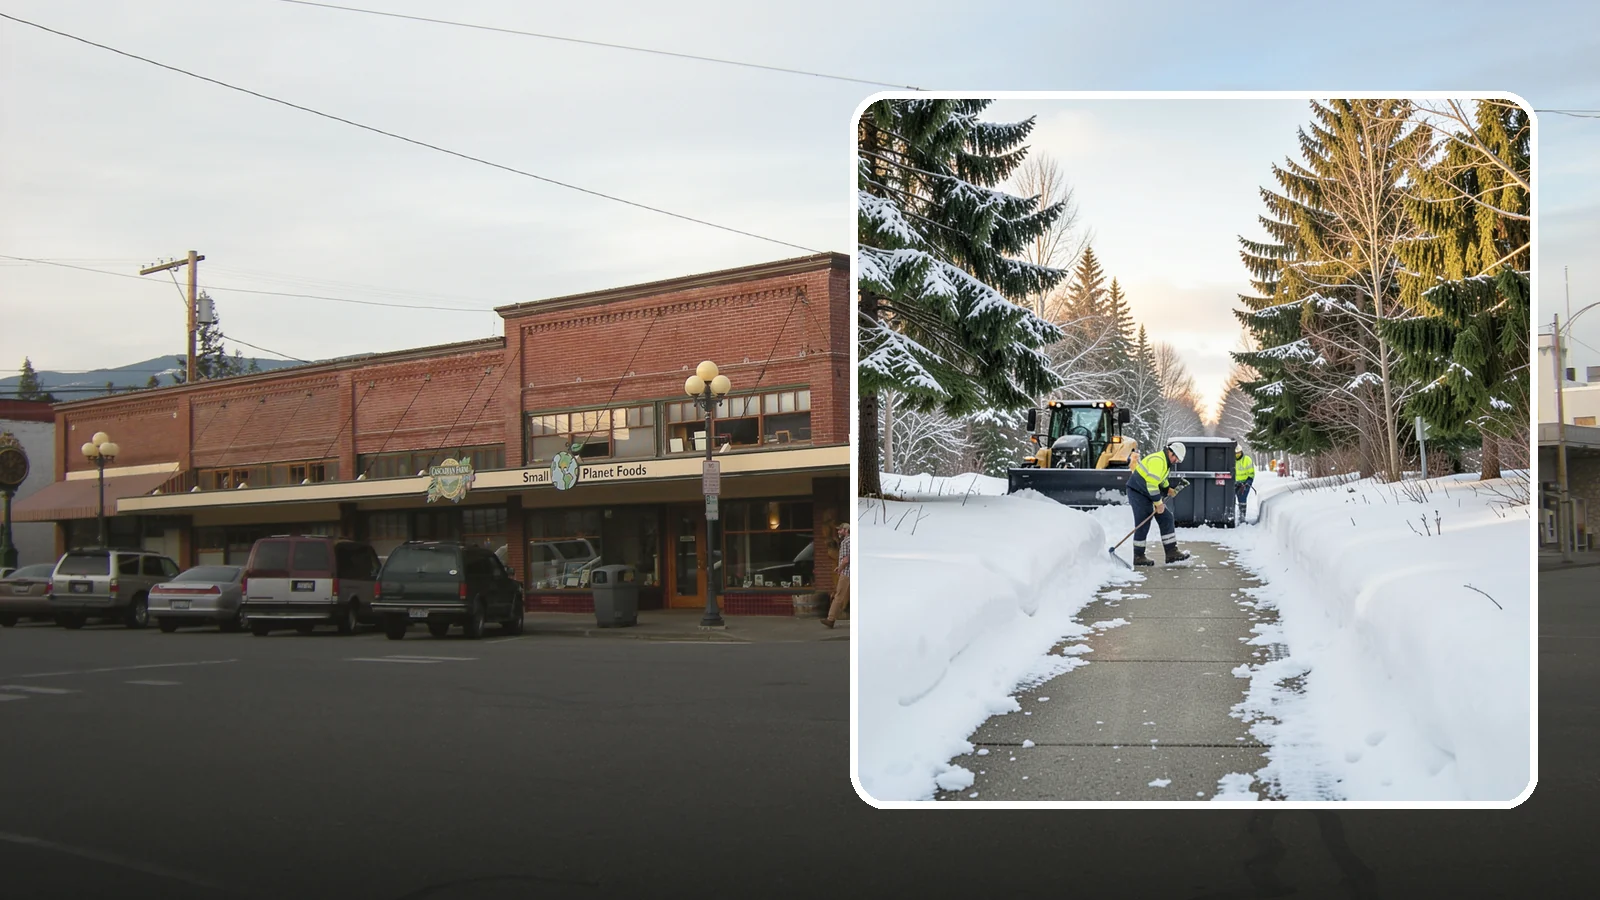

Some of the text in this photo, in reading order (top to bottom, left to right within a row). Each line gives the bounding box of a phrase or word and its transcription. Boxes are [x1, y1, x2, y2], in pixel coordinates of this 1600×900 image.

[523, 464, 647, 483] Small Planet Foods
